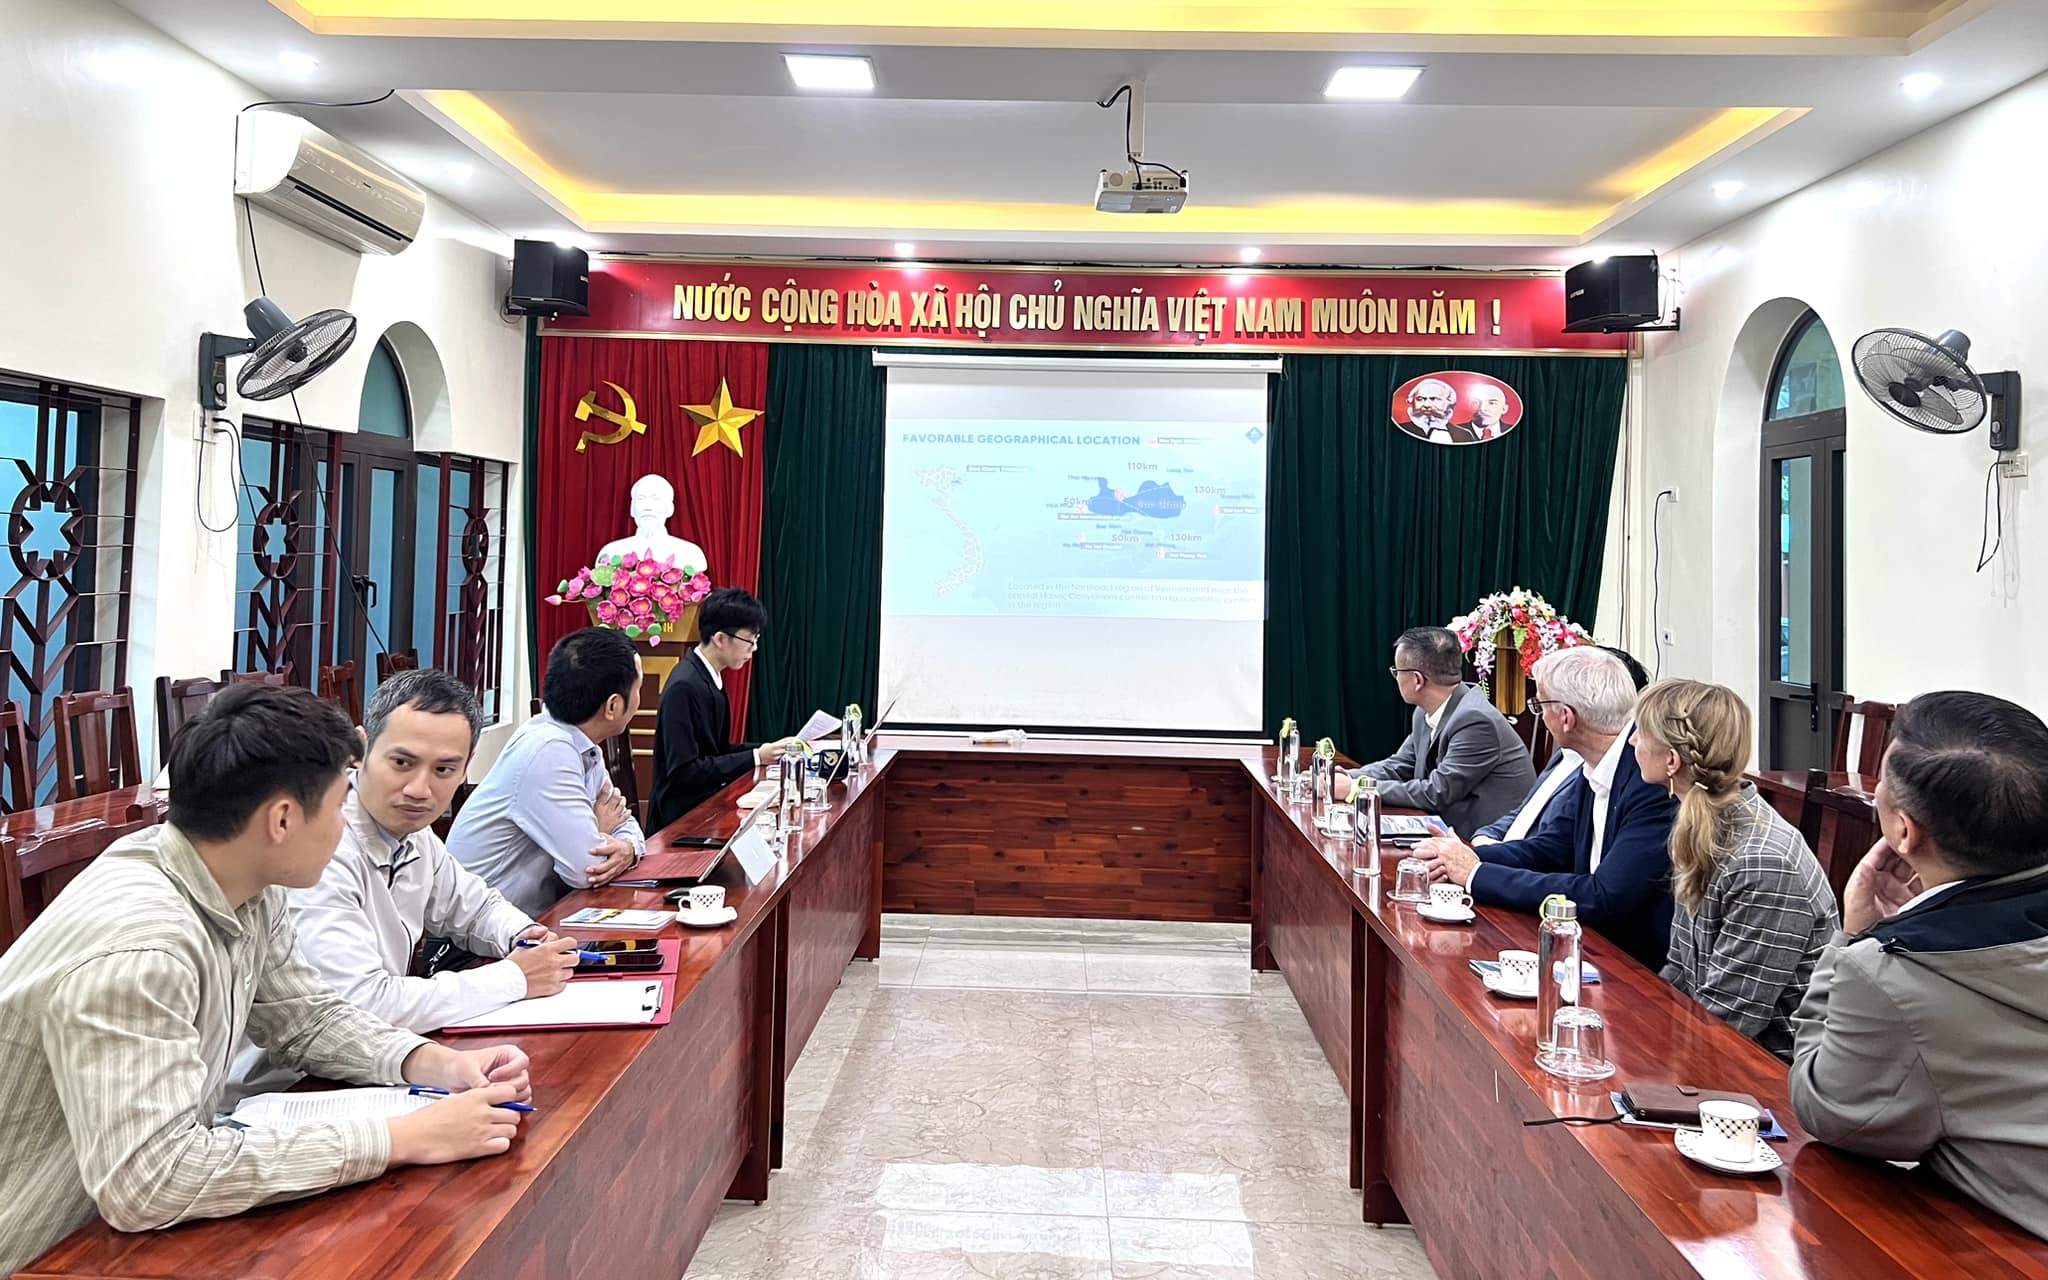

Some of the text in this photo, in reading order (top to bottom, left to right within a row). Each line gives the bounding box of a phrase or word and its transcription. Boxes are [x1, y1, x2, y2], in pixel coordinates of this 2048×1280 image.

[673, 273, 1501, 340] NƯỚC CỘNG HÒA XÃ HỘI CHỦ NGHĨA VIỆT NAM MUÔN NĂM !
[903, 433, 1141, 446] FAVORABLE GEOGRAPHICAL LOCATION
[1127, 461, 1158, 471] 110km
[1193, 485, 1226, 495] 130km
